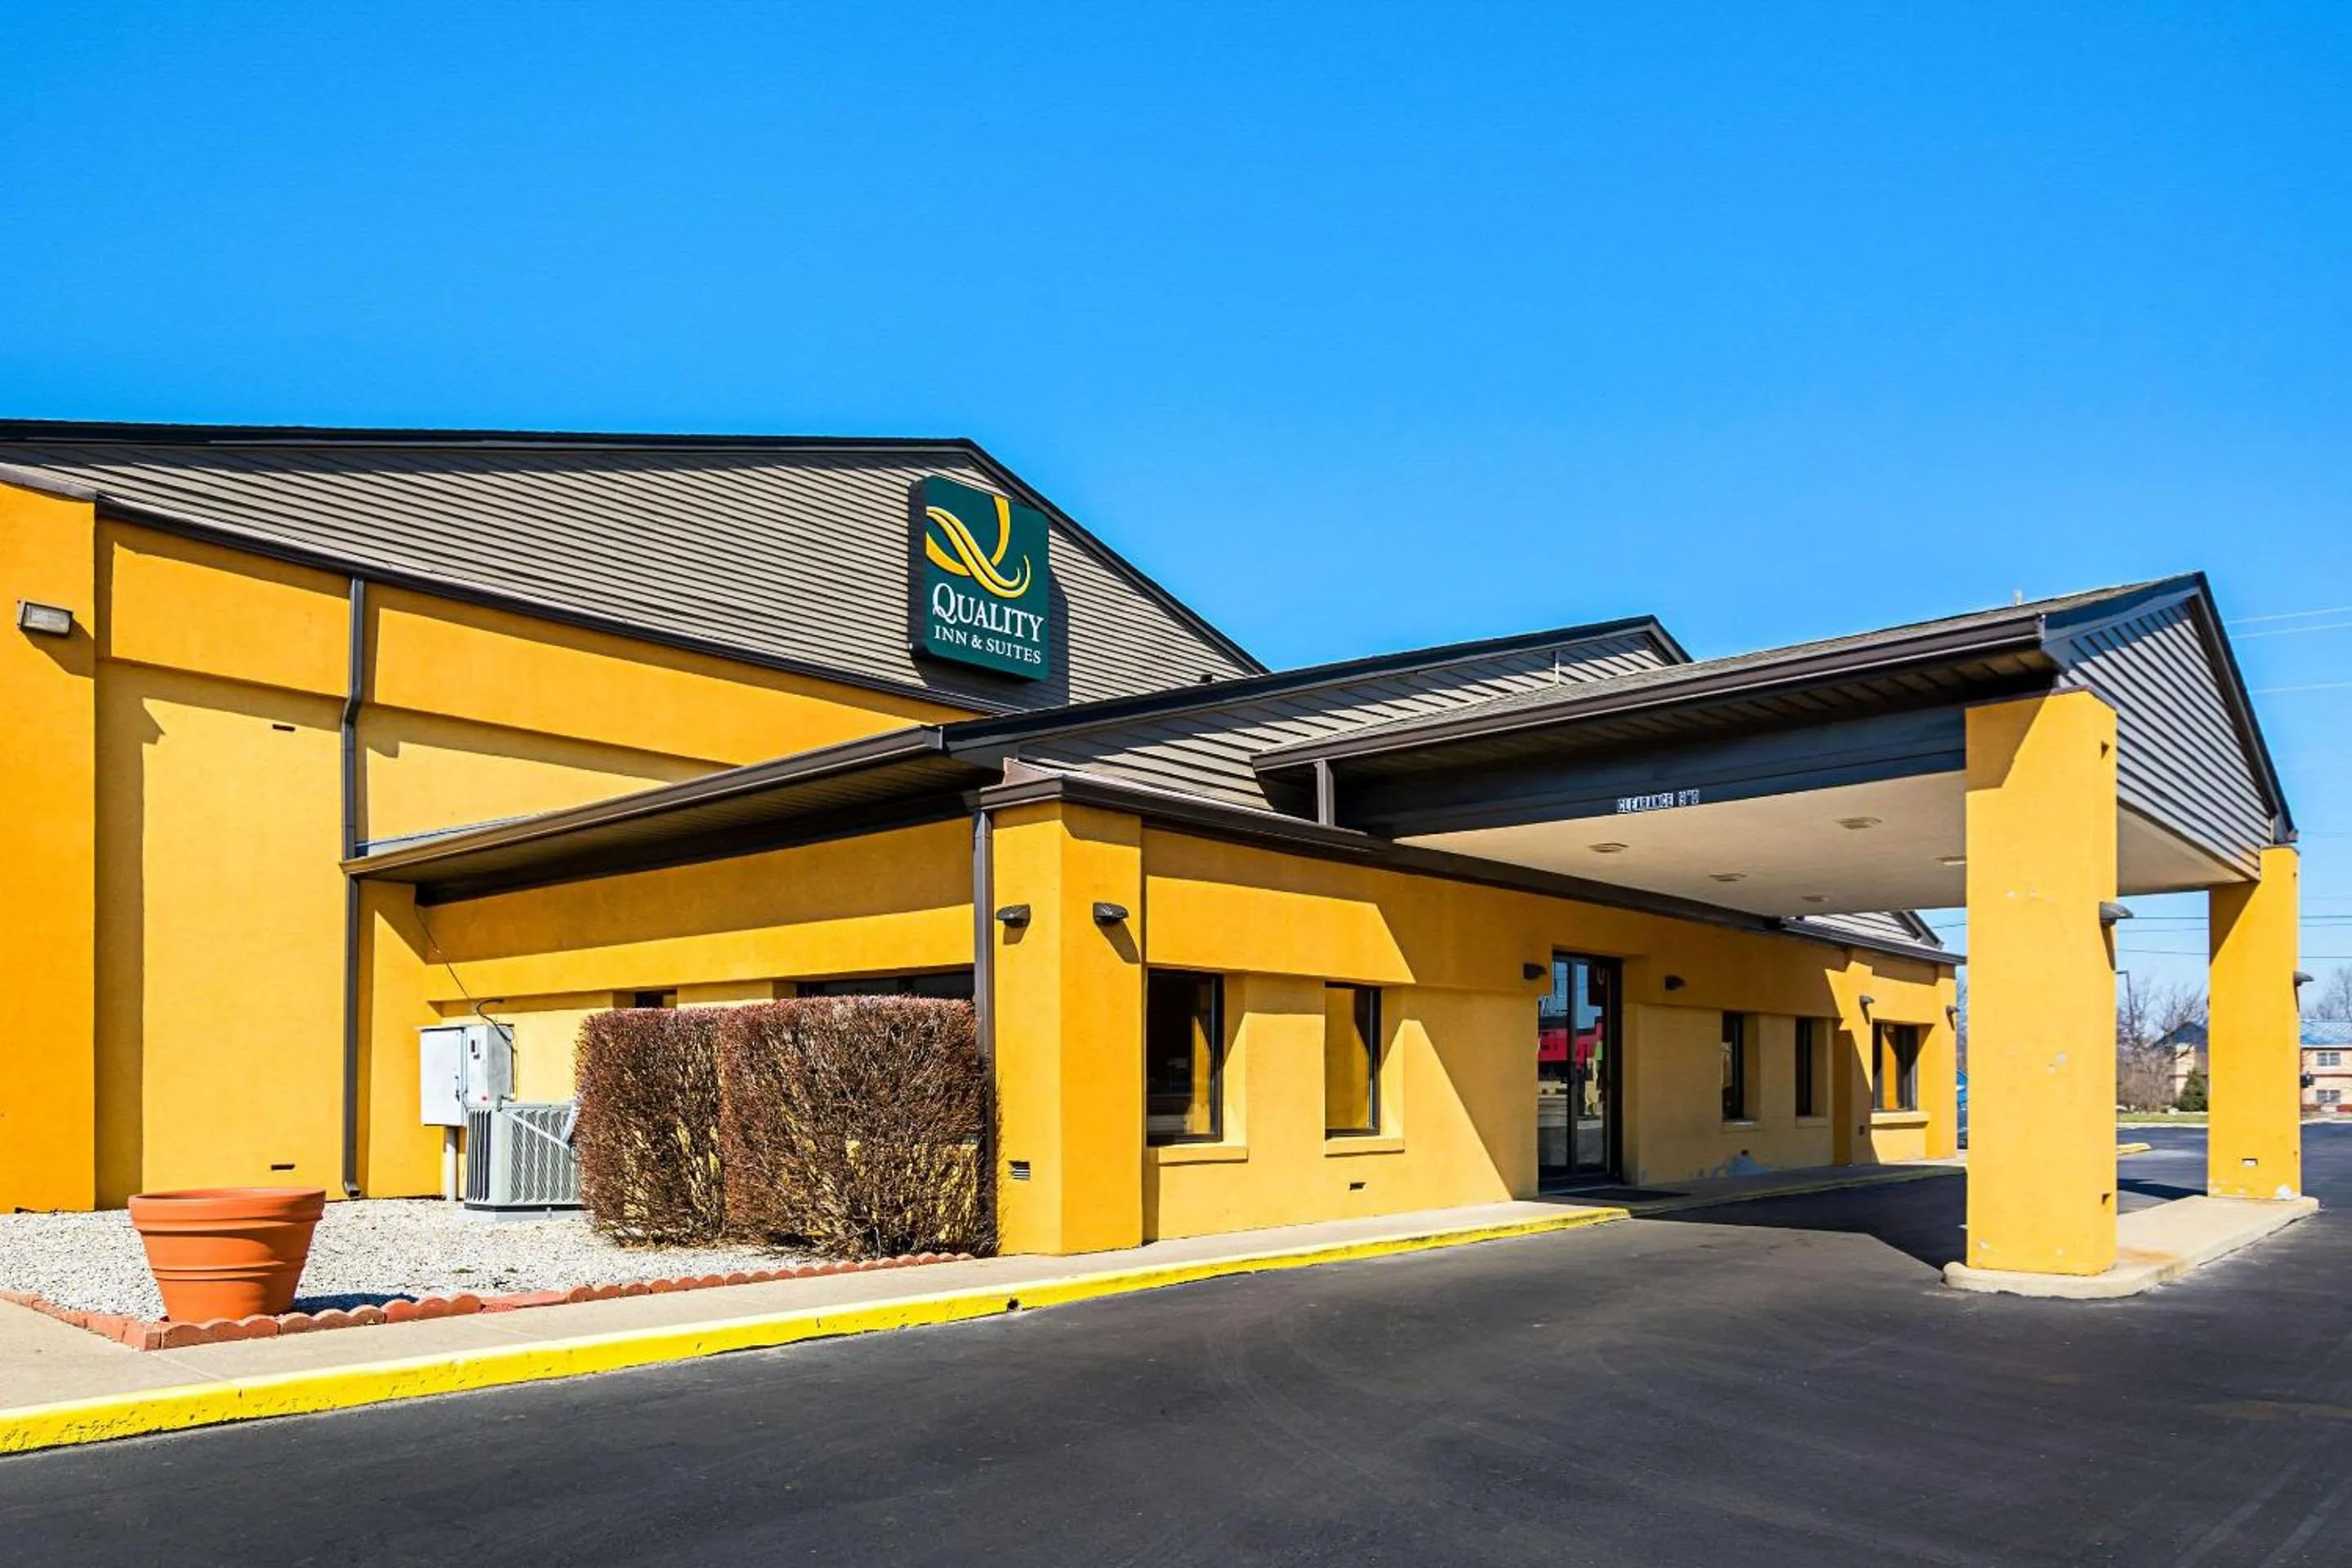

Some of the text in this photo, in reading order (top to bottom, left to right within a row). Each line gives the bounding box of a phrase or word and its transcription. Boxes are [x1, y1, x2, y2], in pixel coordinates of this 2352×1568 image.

[933, 583, 1044, 642] QUALITY
[934, 626, 1041, 664] INN & SUITES
